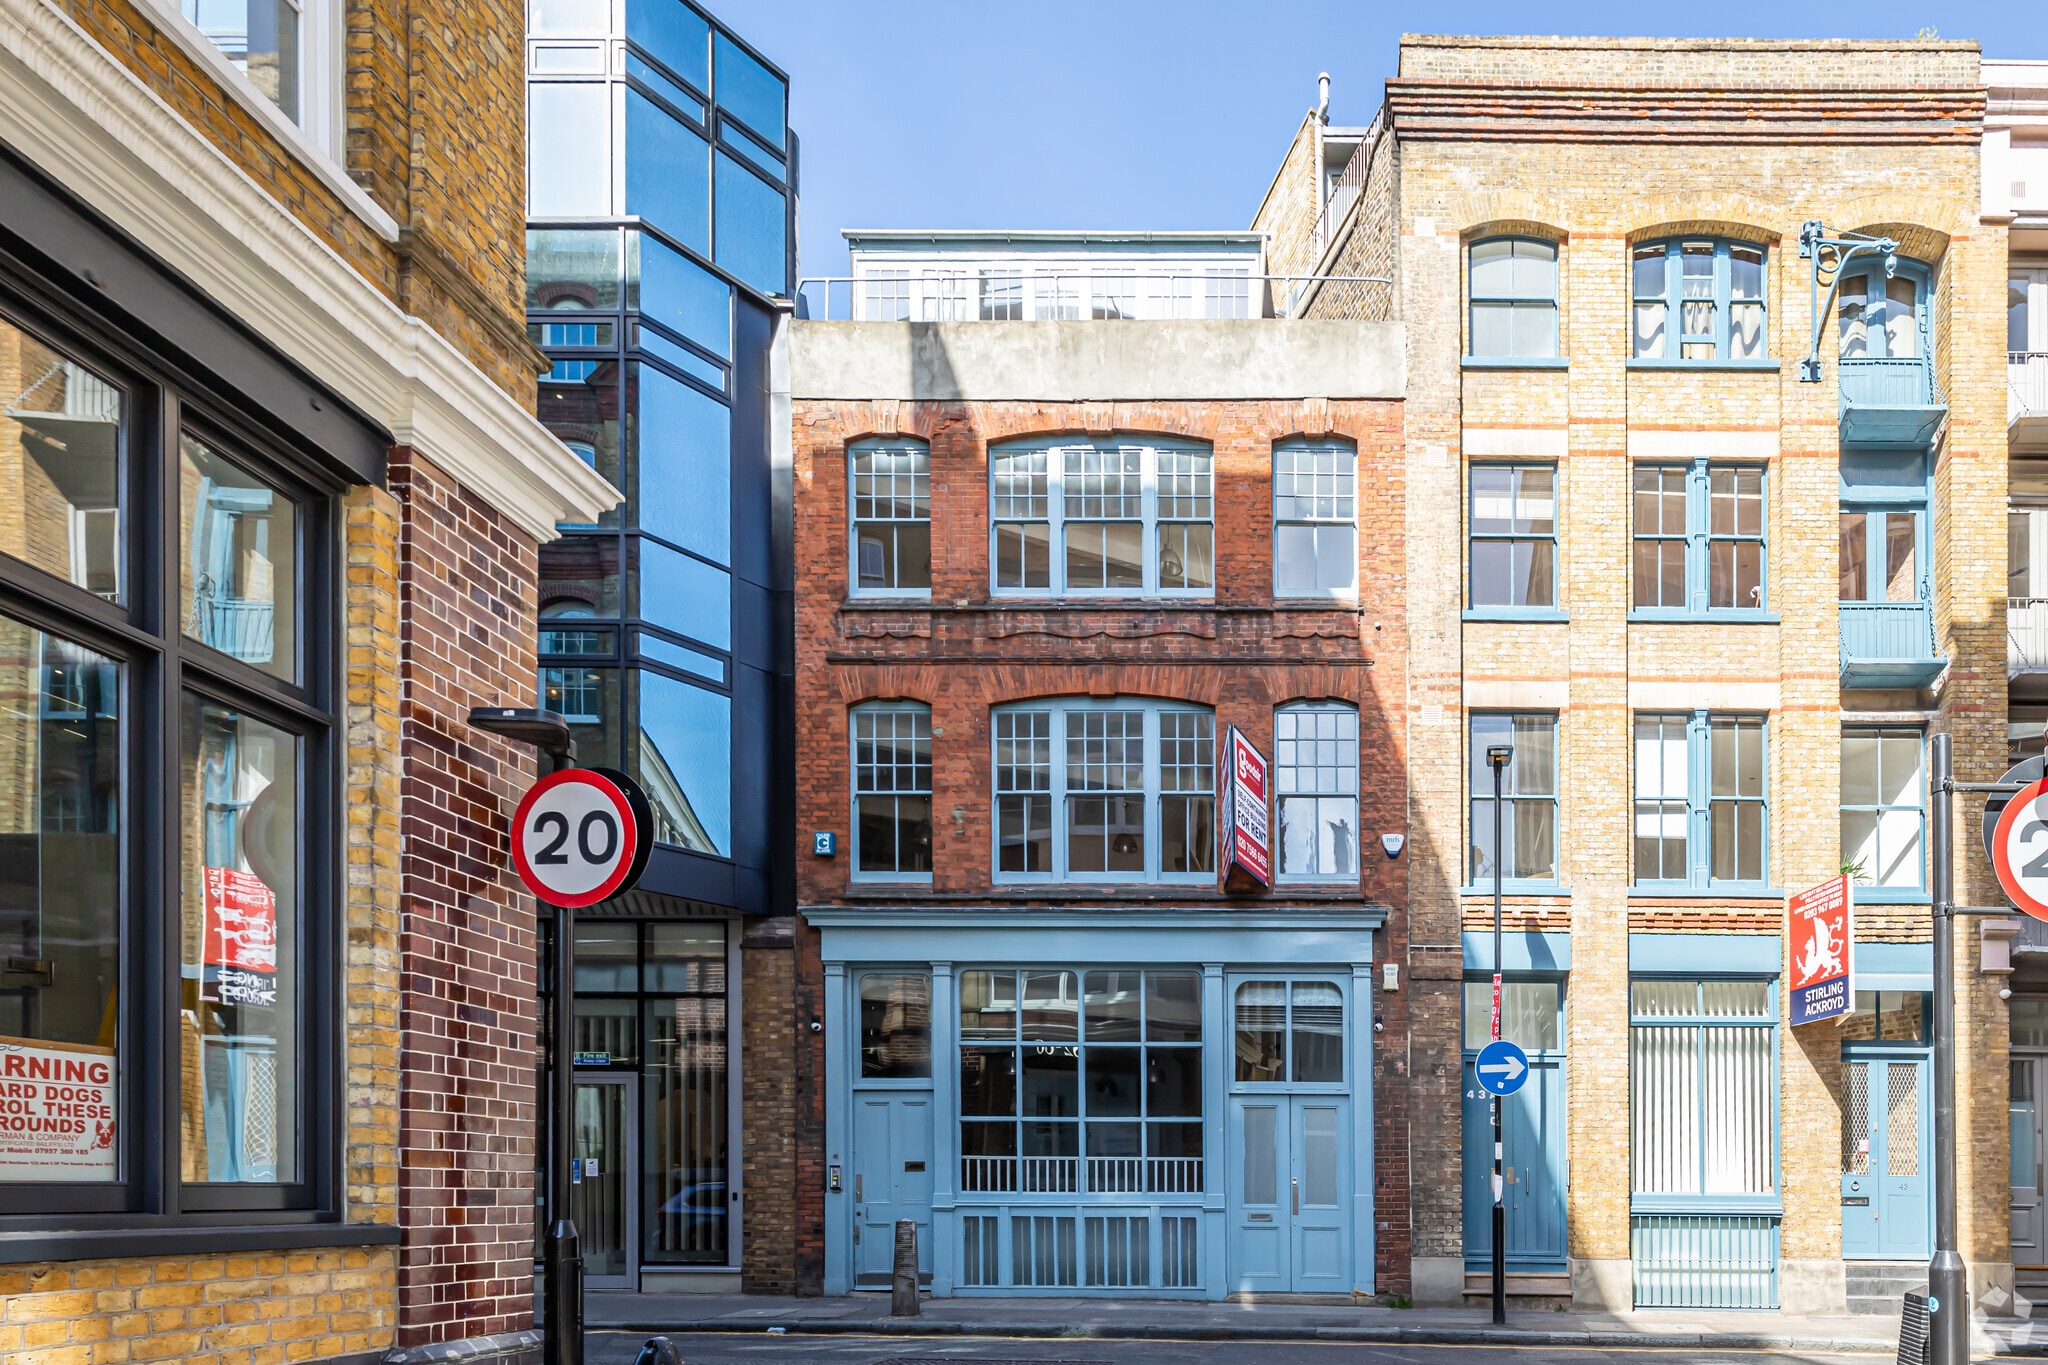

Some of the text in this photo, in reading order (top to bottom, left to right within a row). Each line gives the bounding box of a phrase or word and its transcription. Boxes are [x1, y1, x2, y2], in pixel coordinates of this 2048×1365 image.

[533, 810, 618, 865] 20
[1237, 810, 1267, 846] FOR RENT
[1805, 981, 1844, 1003] STIRLING
[1805, 996, 1844, 1016] ACKROYD
[0, 1054, 109, 1084] RNING
[45, 1086, 103, 1103] DOGS
[43, 1102, 111, 1119] THESE
[36, 1133, 80, 1142] COMPANY
